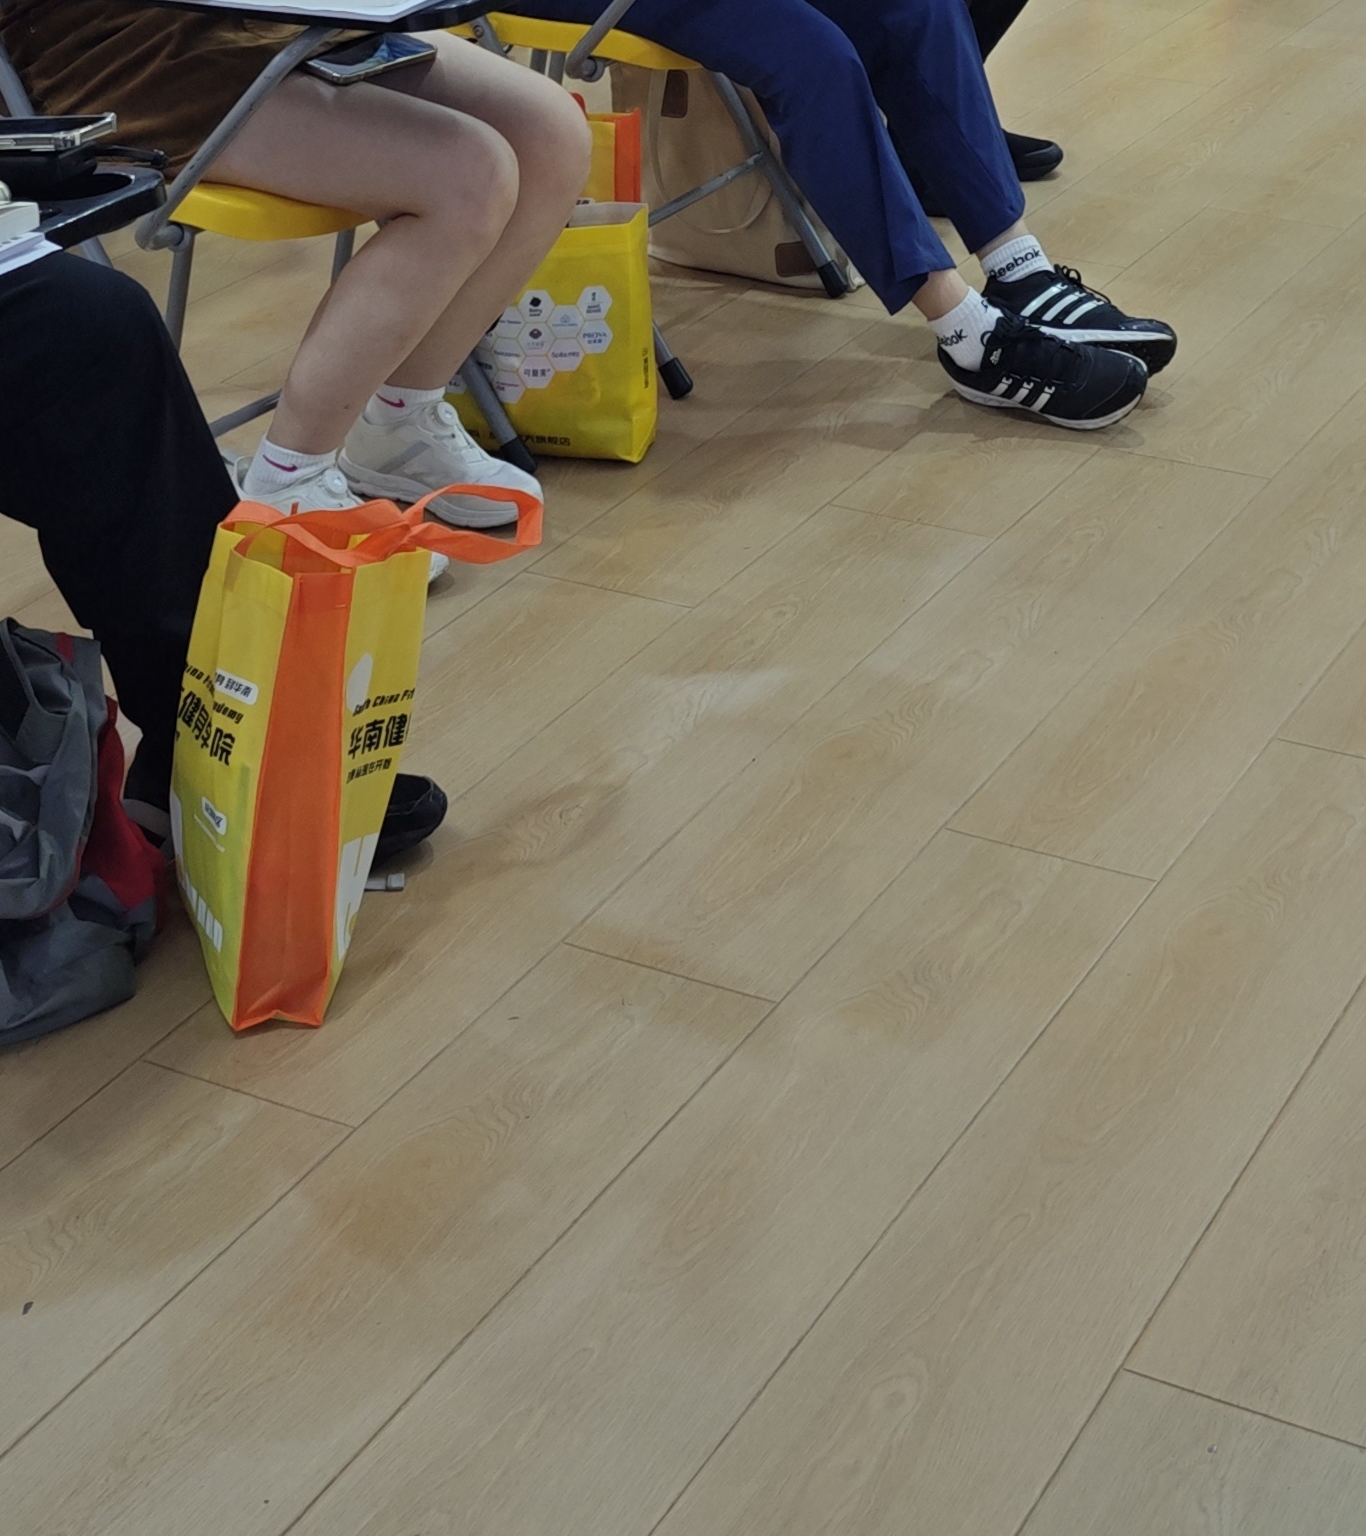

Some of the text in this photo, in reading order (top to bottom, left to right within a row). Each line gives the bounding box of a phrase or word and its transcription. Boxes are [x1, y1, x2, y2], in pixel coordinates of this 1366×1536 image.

[988, 247, 1043, 278] Reebok
[372, 692, 400, 708] China
[348, 711, 413, 760] 华南健
